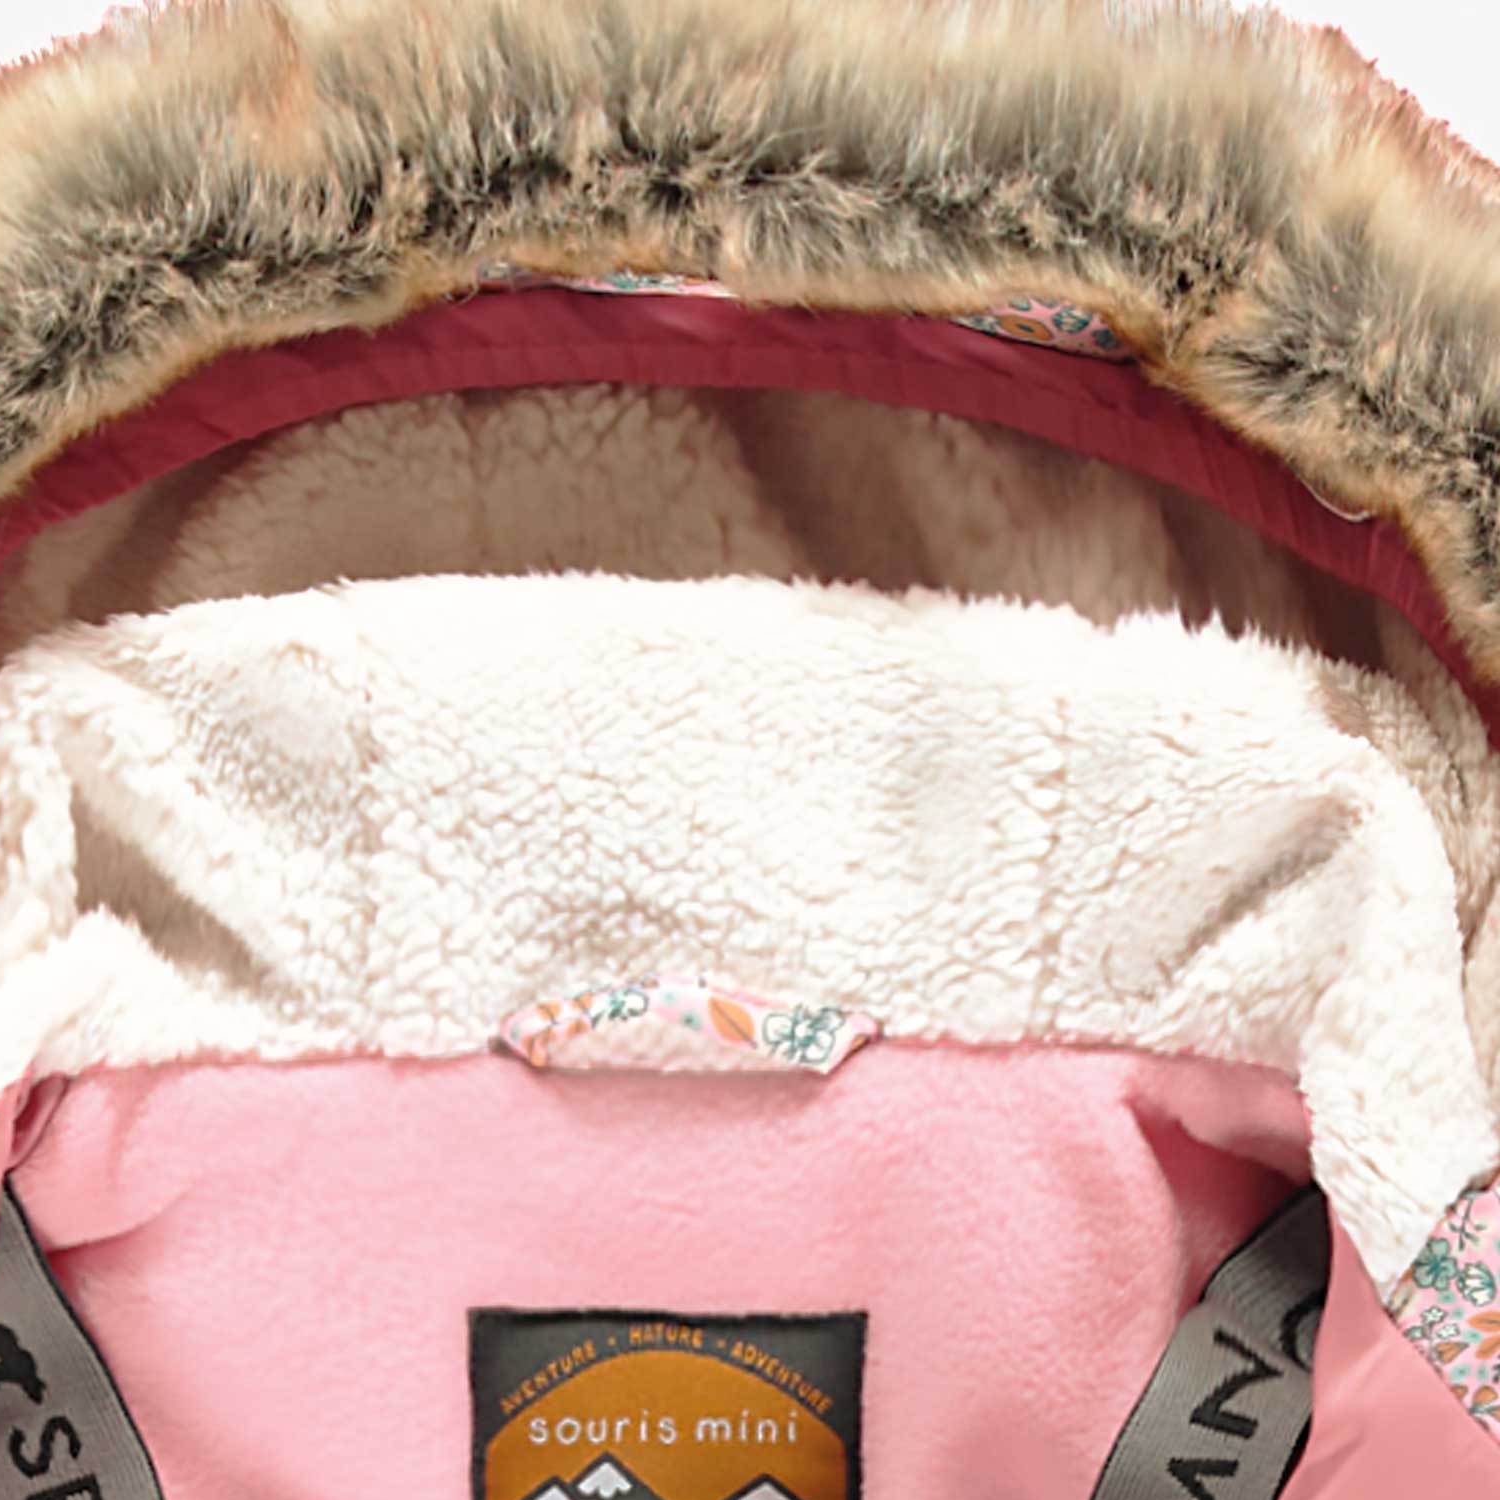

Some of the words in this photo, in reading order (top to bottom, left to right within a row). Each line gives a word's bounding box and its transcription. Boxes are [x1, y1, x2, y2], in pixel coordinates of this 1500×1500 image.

[501, 1339, 597, 1414] AVENTURE
[628, 1325, 704, 1348] NATURE
[731, 1341, 833, 1414] ADVENTURE
[528, 1410, 678, 1445] souris
[695, 1408, 798, 1443] mini
